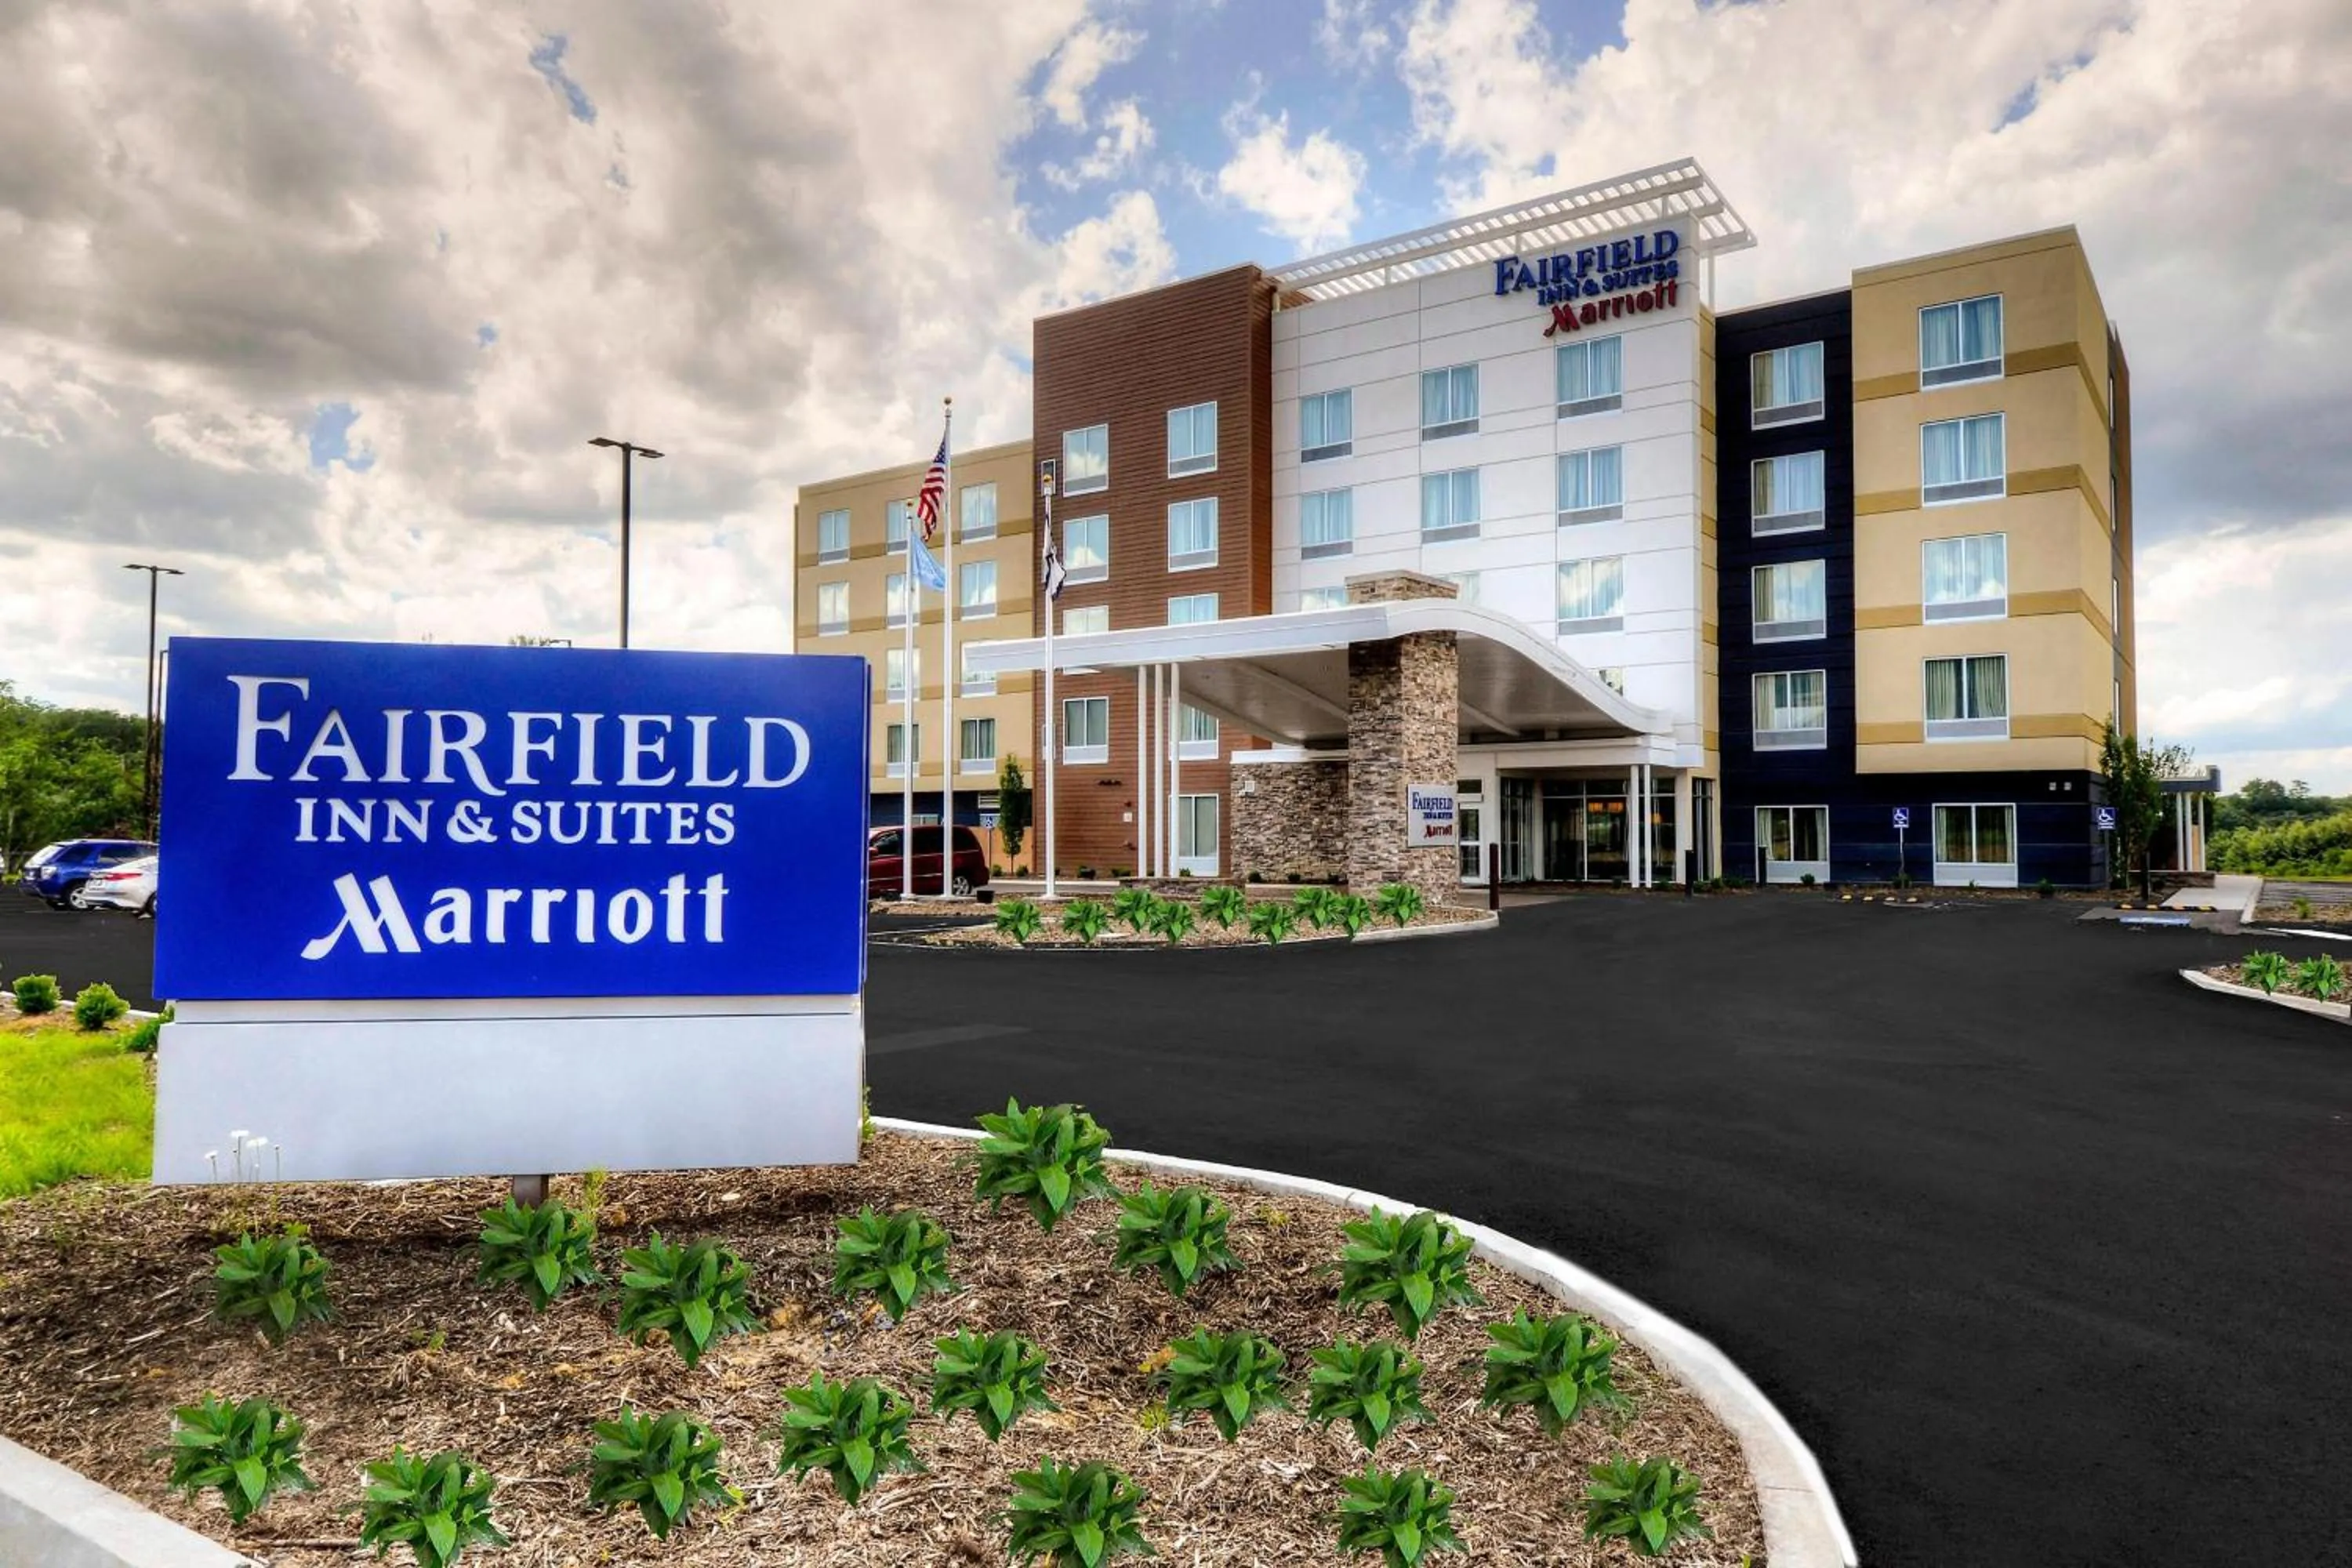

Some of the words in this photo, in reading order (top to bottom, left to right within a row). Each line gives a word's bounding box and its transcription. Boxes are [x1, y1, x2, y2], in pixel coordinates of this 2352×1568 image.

[1493, 229, 1679, 296] FAIRFIELD
[1537, 277, 1580, 306] INN
[1602, 260, 1679, 292] SUITES
[1543, 277, 1678, 337] Marriott
[227, 675, 811, 797] FAIRFIELD
[295, 797, 434, 844] INN
[446, 800, 498, 844] &
[510, 800, 735, 845] SUITES
[300, 872, 730, 961] Marriott
